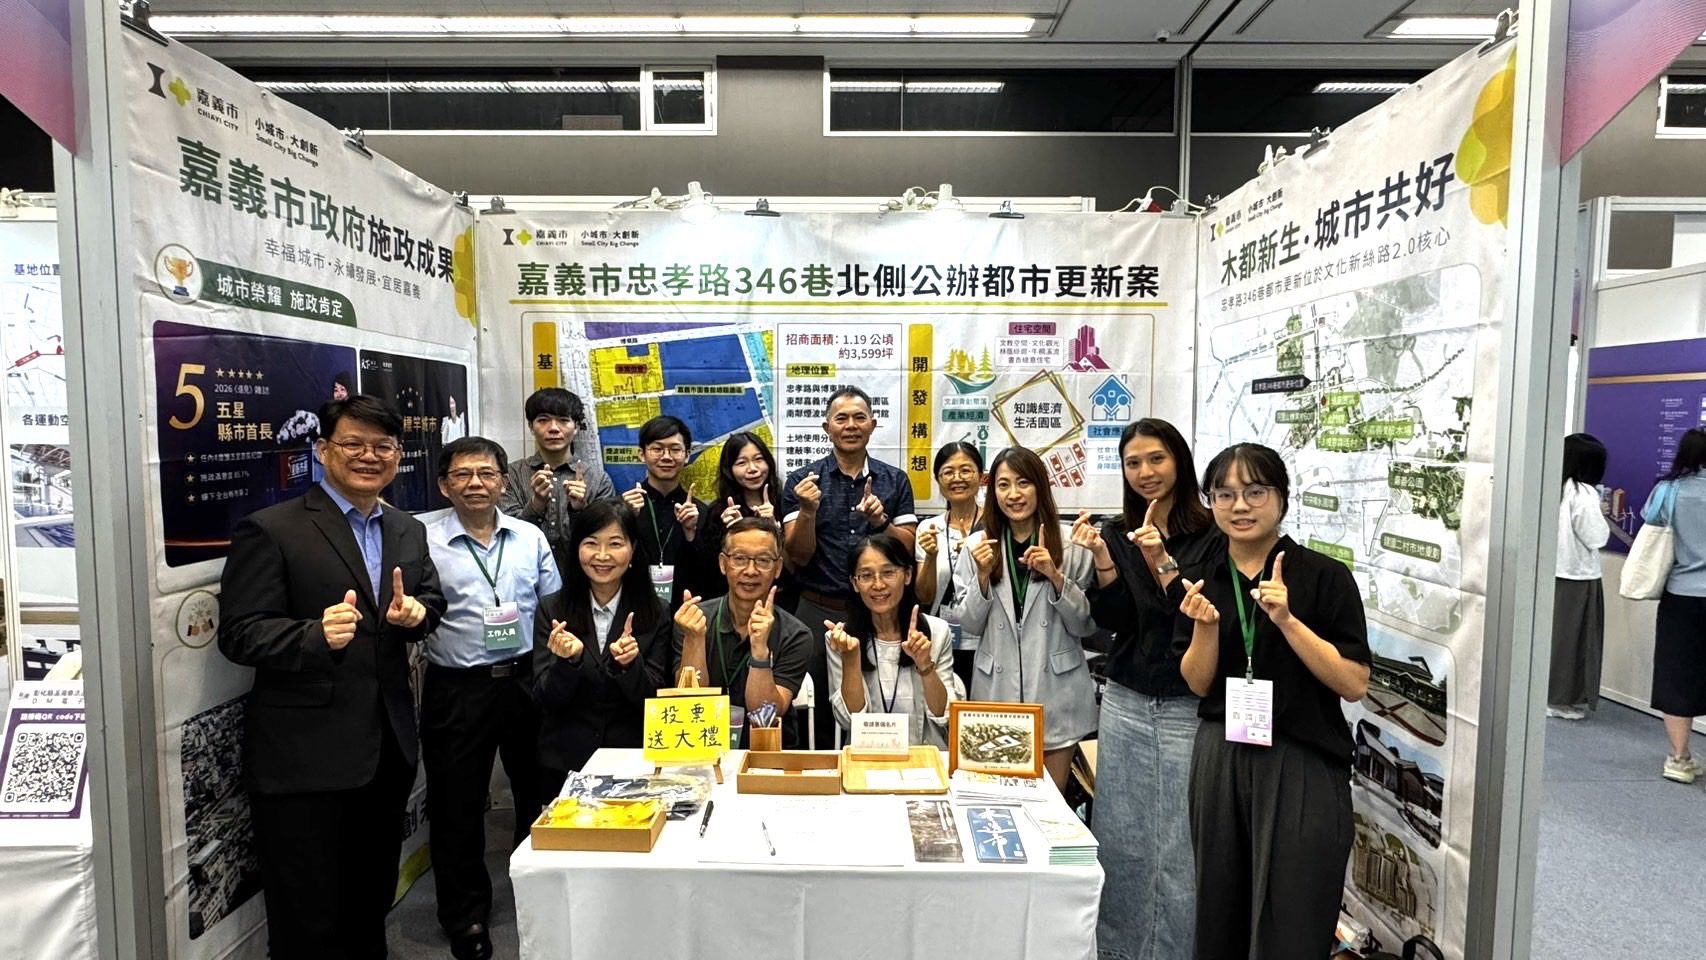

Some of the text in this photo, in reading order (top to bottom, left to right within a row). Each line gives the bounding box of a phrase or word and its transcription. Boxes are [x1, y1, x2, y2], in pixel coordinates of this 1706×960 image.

[197, 88, 239, 119] 嘉義市
[197, 108, 239, 131] CHIAYI CITY
[274, 142, 286, 154] City
[287, 148, 297, 159] Big
[298, 153, 318, 168] Change
[177, 136, 455, 283] 嘉義市政府施政成果
[536, 229, 568, 240] 嘉義市
[597, 240, 609, 248] City
[610, 240, 618, 248] Big
[620, 240, 639, 248] Change
[517, 262, 1160, 298] 嘉義市忠孝路346巷北側公辦都市更新案
[217, 273, 343, 319] 城市榮耀 施政肯定
[1013, 324, 1052, 335] 住宅空間
[843, 335, 867, 345] 1.19
[870, 334, 894, 346] 公頃
[838, 348, 894, 360] 約3,599坪
[791, 365, 830, 376] 地理位置
[169, 363, 206, 430] 5
[216, 402, 245, 419] 五星
[947, 410, 985, 420] 產業經濟
[1013, 402, 1062, 415] 知識經濟
[403, 415, 437, 432] 標竿城市
[1013, 416, 1062, 429] 生活園區
[218, 423, 273, 441] 縣市首長
[1094, 427, 1122, 436] 社會應
[488, 628, 516, 638] 工作人員
[661, 703, 706, 724] 投票
[647, 725, 722, 750] 送大禮
